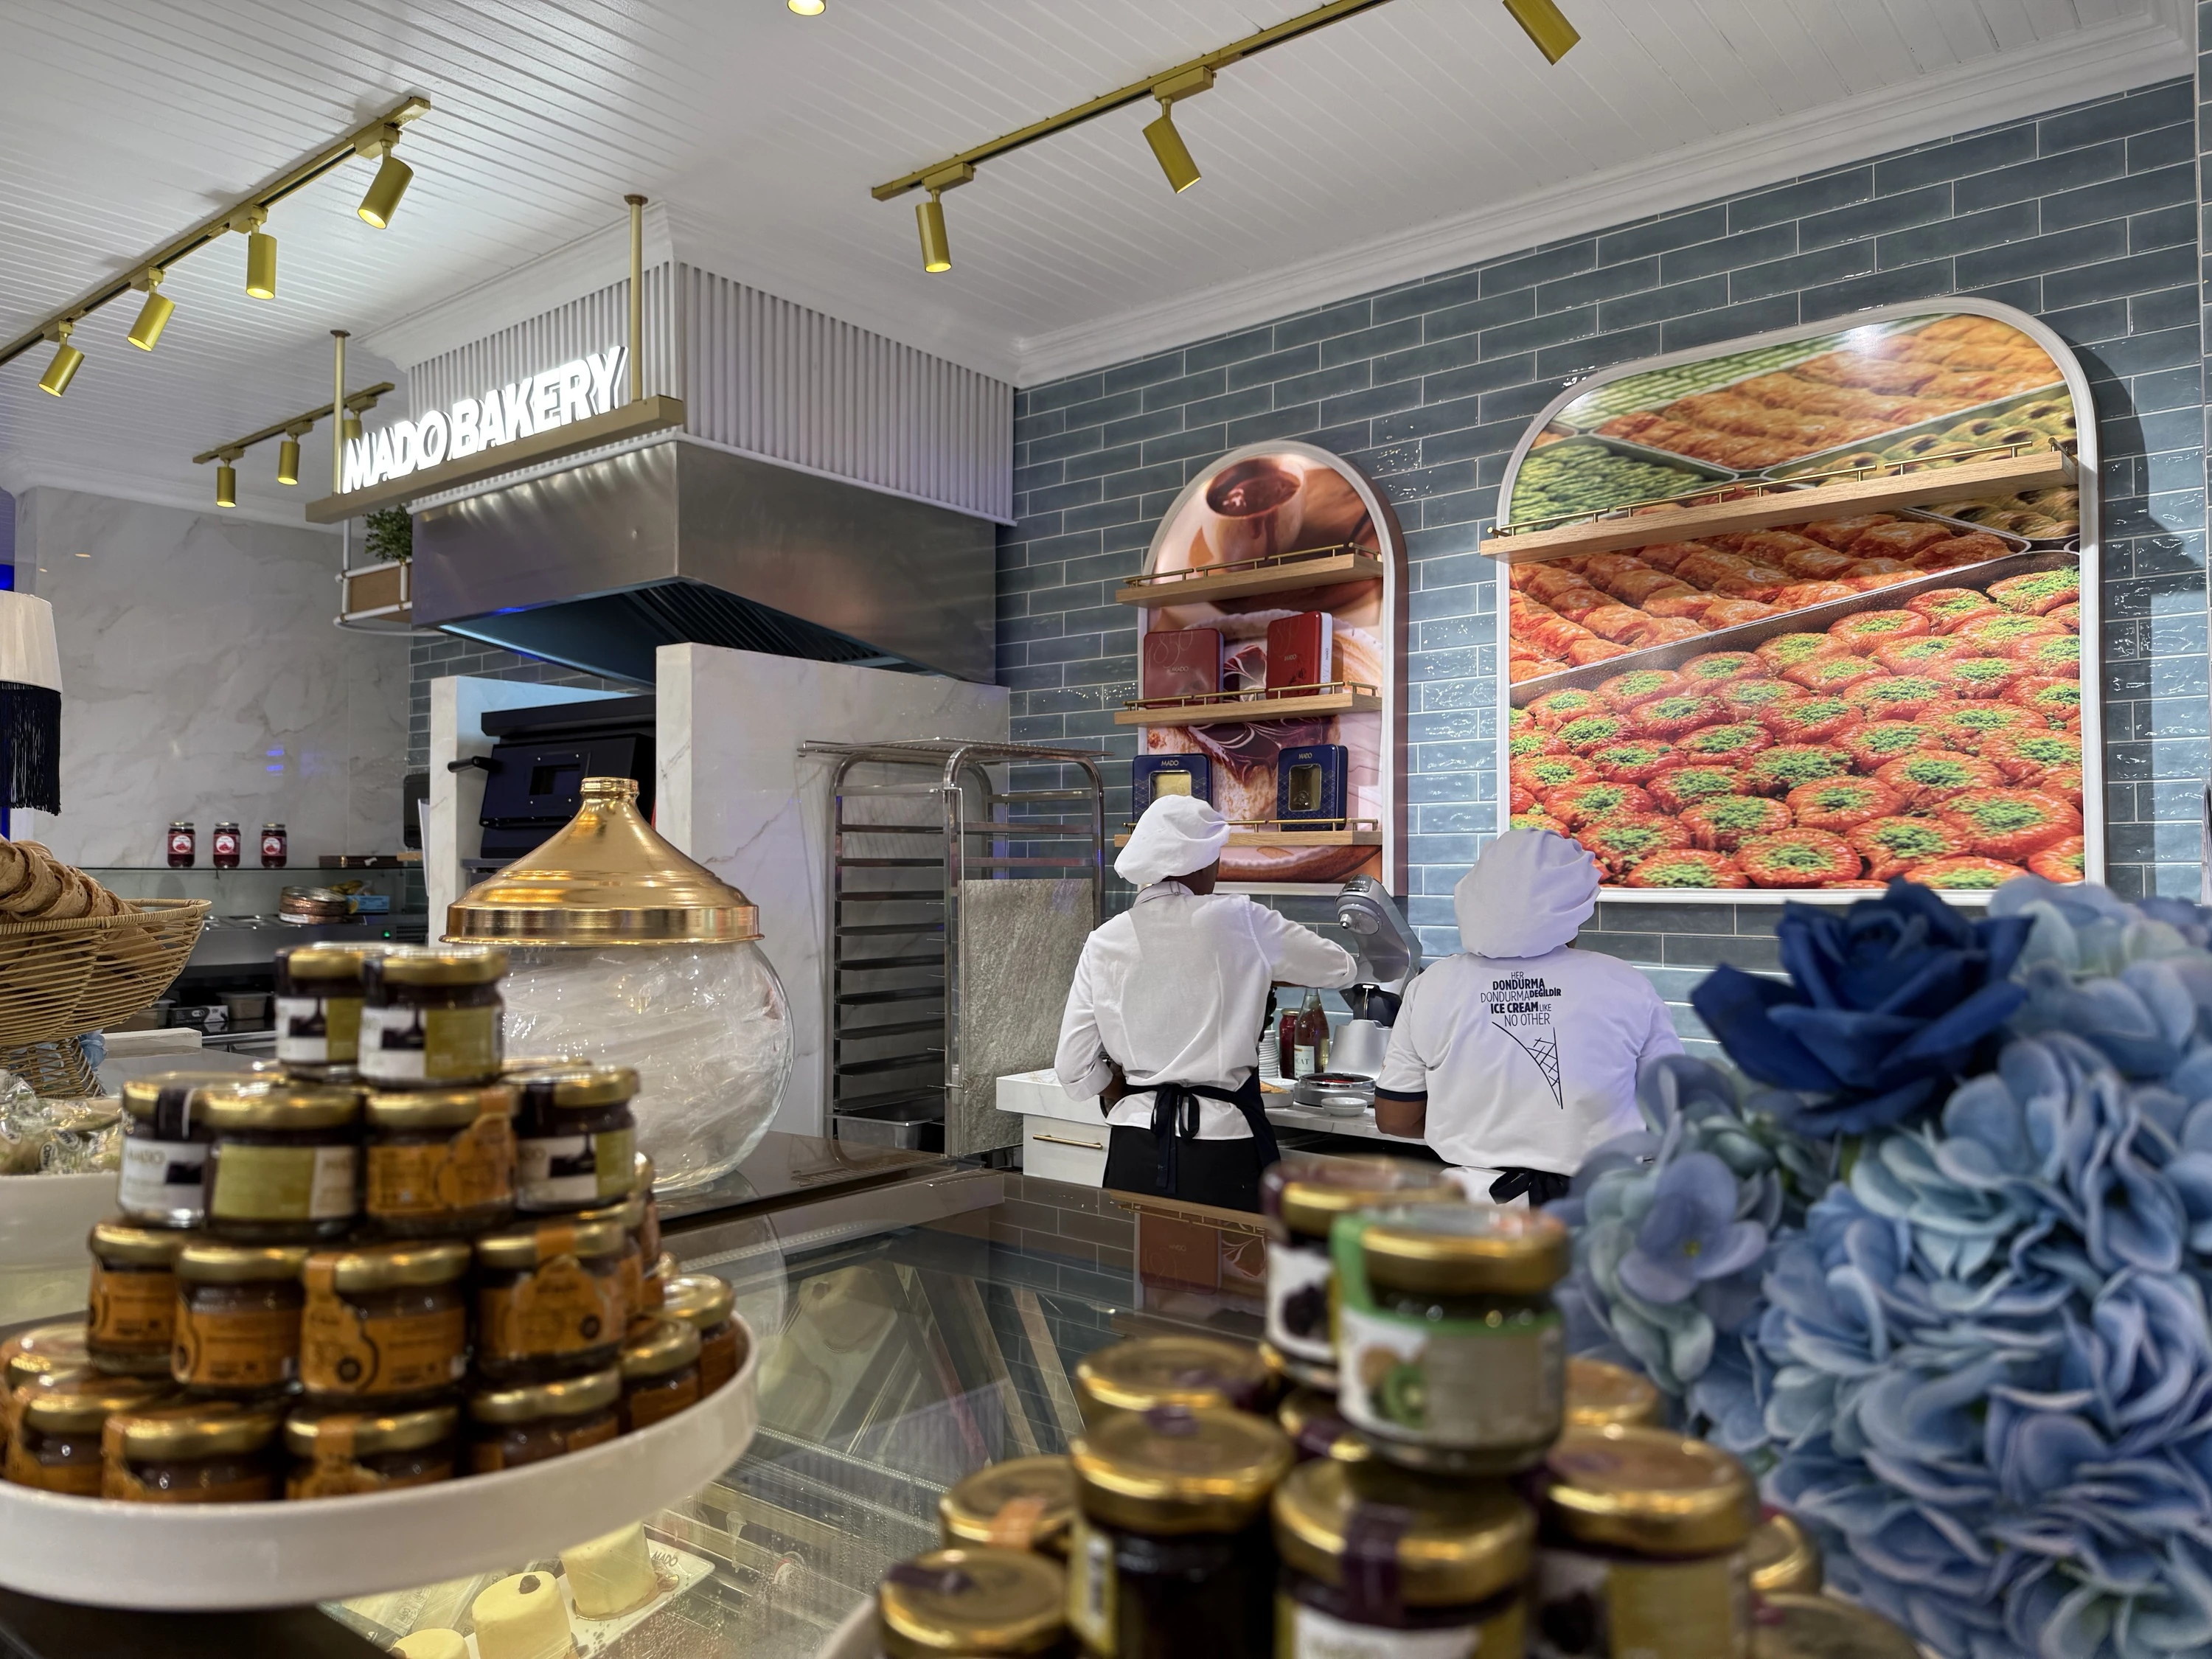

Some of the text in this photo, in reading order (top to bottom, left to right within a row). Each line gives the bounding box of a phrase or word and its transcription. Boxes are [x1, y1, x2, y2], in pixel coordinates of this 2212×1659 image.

[343, 345, 629, 494] MADO BAKERY
[1284, 653, 1298, 661] MADO
[1511, 971, 1524, 979] HER
[1492, 978, 1545, 991] DONDURMA
[1481, 990, 1531, 1003] DONDURMA
[1490, 1001, 1552, 1014] ICE CREAM LIKE
[1504, 1012, 1551, 1026] NO OTHER
[651, 1551, 679, 1567] MADO
